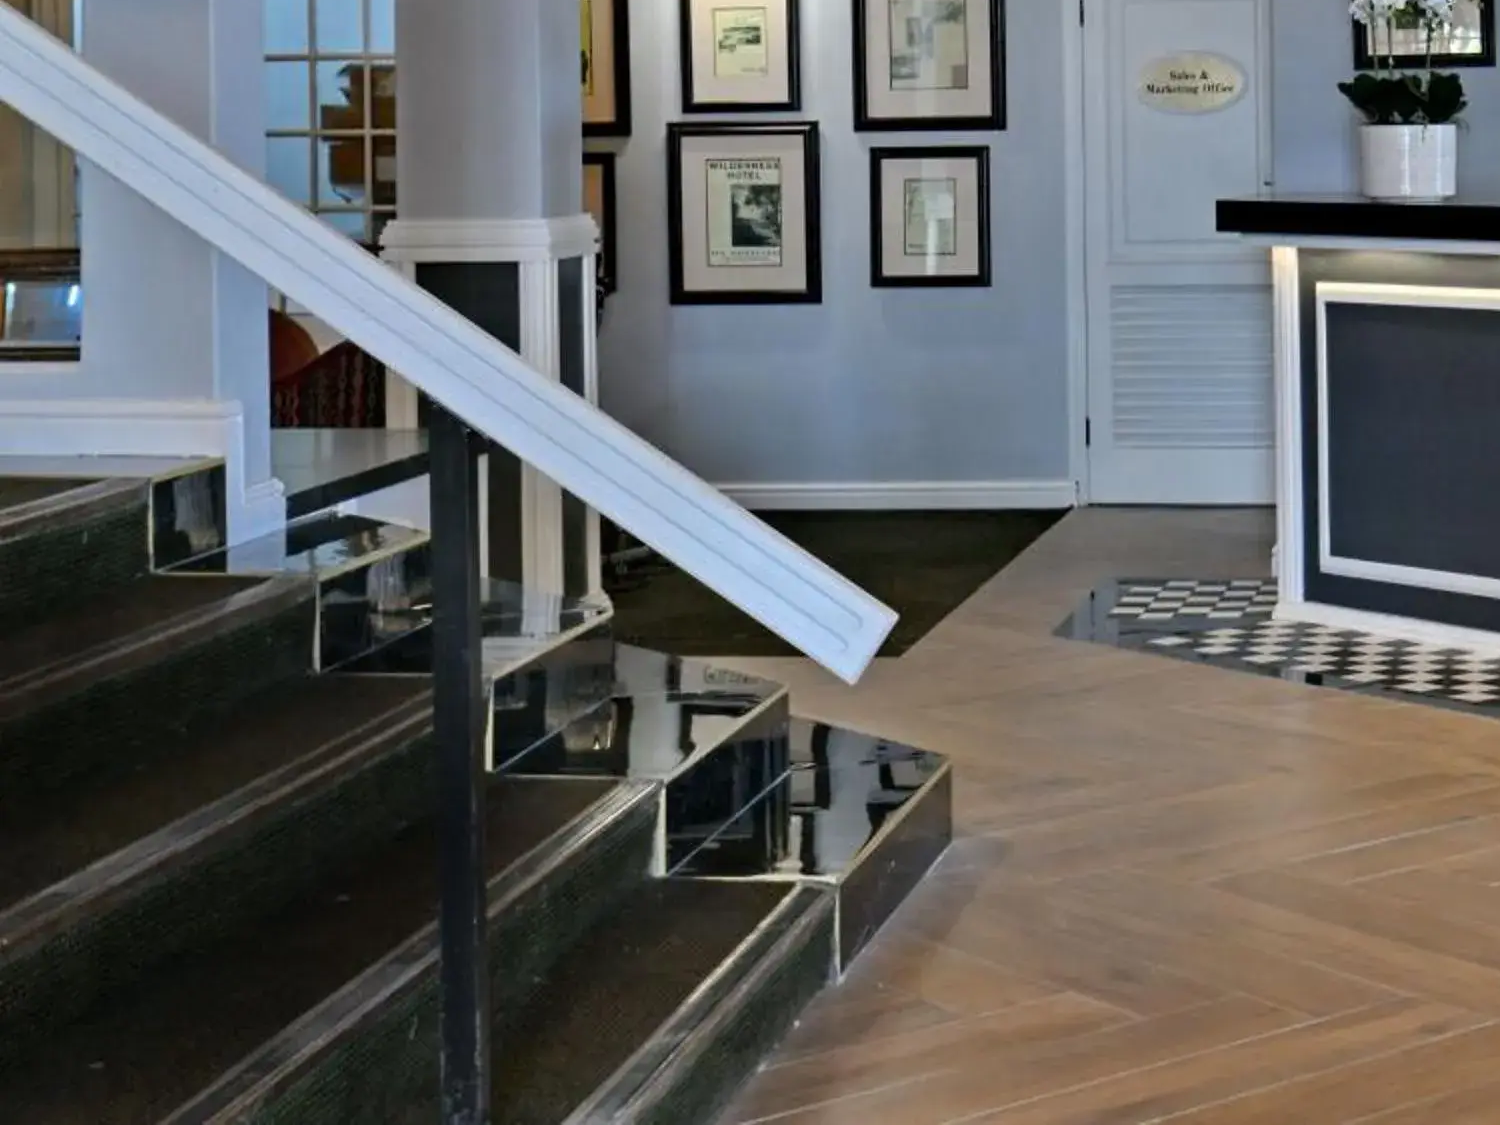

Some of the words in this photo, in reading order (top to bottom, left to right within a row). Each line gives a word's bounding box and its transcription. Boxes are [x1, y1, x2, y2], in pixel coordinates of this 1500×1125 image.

[1146, 83, 1199, 95] Marketing
[1202, 83, 1234, 92] Office
[727, 171, 762, 180] HOTEL
